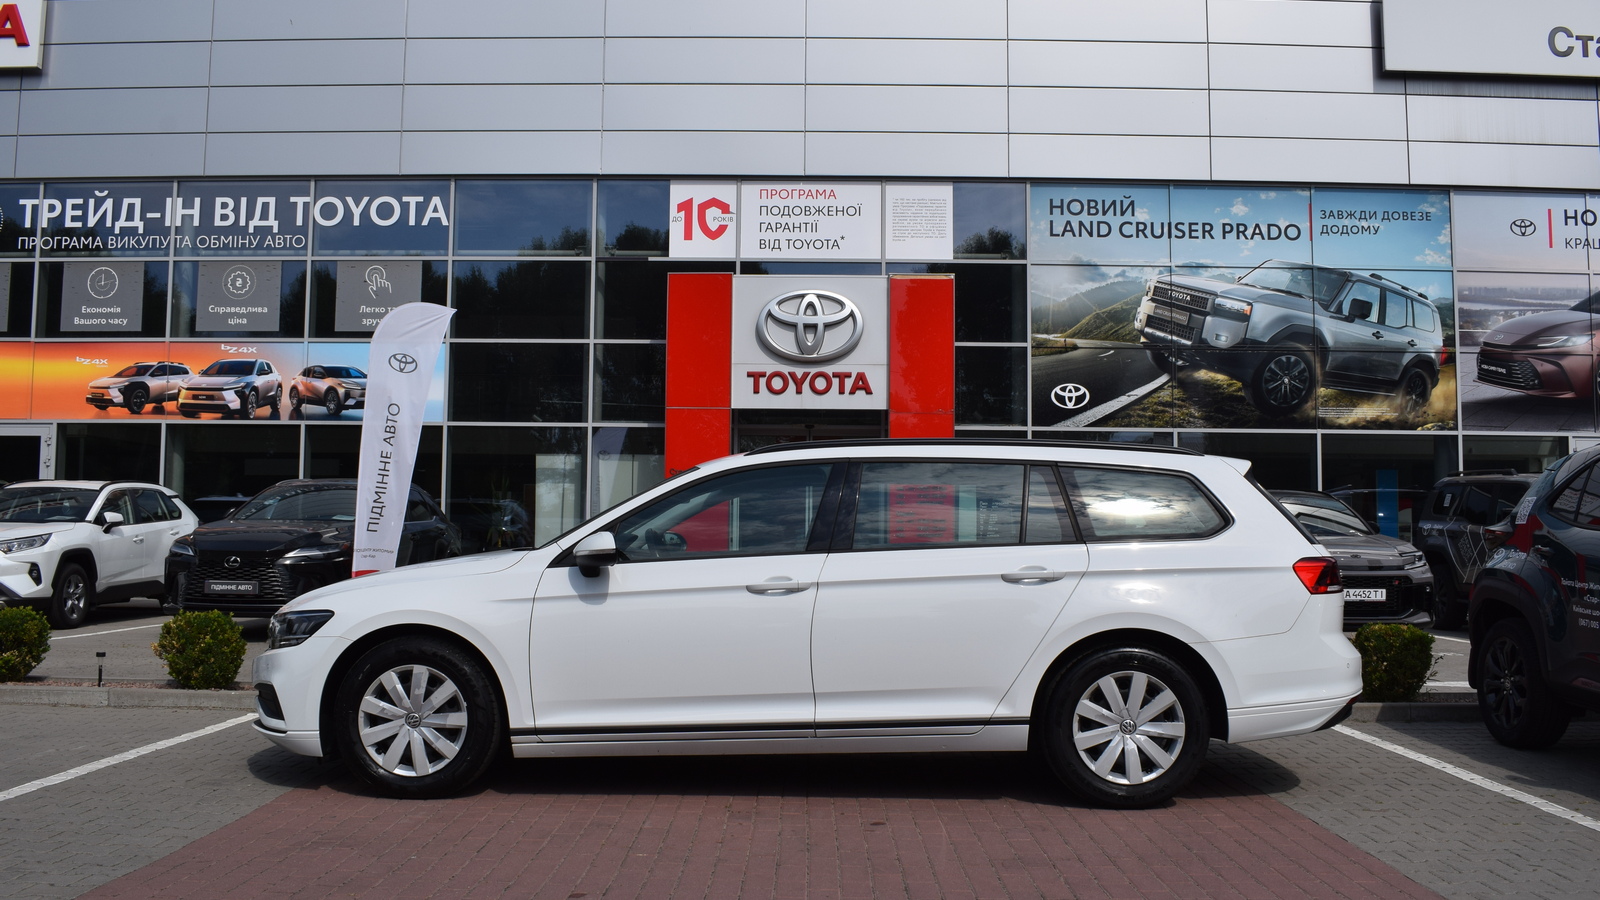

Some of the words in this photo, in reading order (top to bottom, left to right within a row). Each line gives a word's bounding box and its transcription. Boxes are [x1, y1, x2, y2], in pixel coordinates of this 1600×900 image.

[759, 188, 837, 200] ПРОГРАМА
[19, 190, 201, 234] ТРЕЙД-ІН
[214, 197, 279, 233] ВІД
[290, 196, 449, 226] TOYOTA
[759, 203, 863, 219] ПОДОВЖЕНОЇ
[1049, 195, 1135, 217] НОВИЙ
[1320, 209, 1377, 222] ЗАВЖДИ
[1381, 211, 1432, 223] ДОВЕЗЕ
[759, 219, 819, 233] ГАРАНТІЇ
[1049, 220, 1112, 238] LAND
[1118, 221, 1215, 239] CRUISER
[1221, 222, 1302, 241] PRADO
[1320, 224, 1380, 236] ДОДОМУ
[18, 236, 103, 249] ПРОГРАМА
[108, 235, 171, 249] ВИКУПУ
[174, 235, 192, 248] ТА
[196, 235, 260, 248] ОБМІНУ
[263, 234, 306, 248] АВТО
[759, 239, 782, 252] ВІД
[1168, 290, 1191, 301] TOYOTA
[81, 305, 121, 314] Економія
[208, 304, 268, 314] Справедлива
[359, 305, 386, 313] Легко
[74, 316, 106, 325] Вашого
[108, 318, 128, 326] часу
[228, 316, 247, 325] ціна
[747, 371, 873, 395] TOYOTA
[366, 450, 393, 533] ПІДМІННЕ
[382, 402, 400, 447] АВТО
[1352, 590, 1372, 599] 4452
